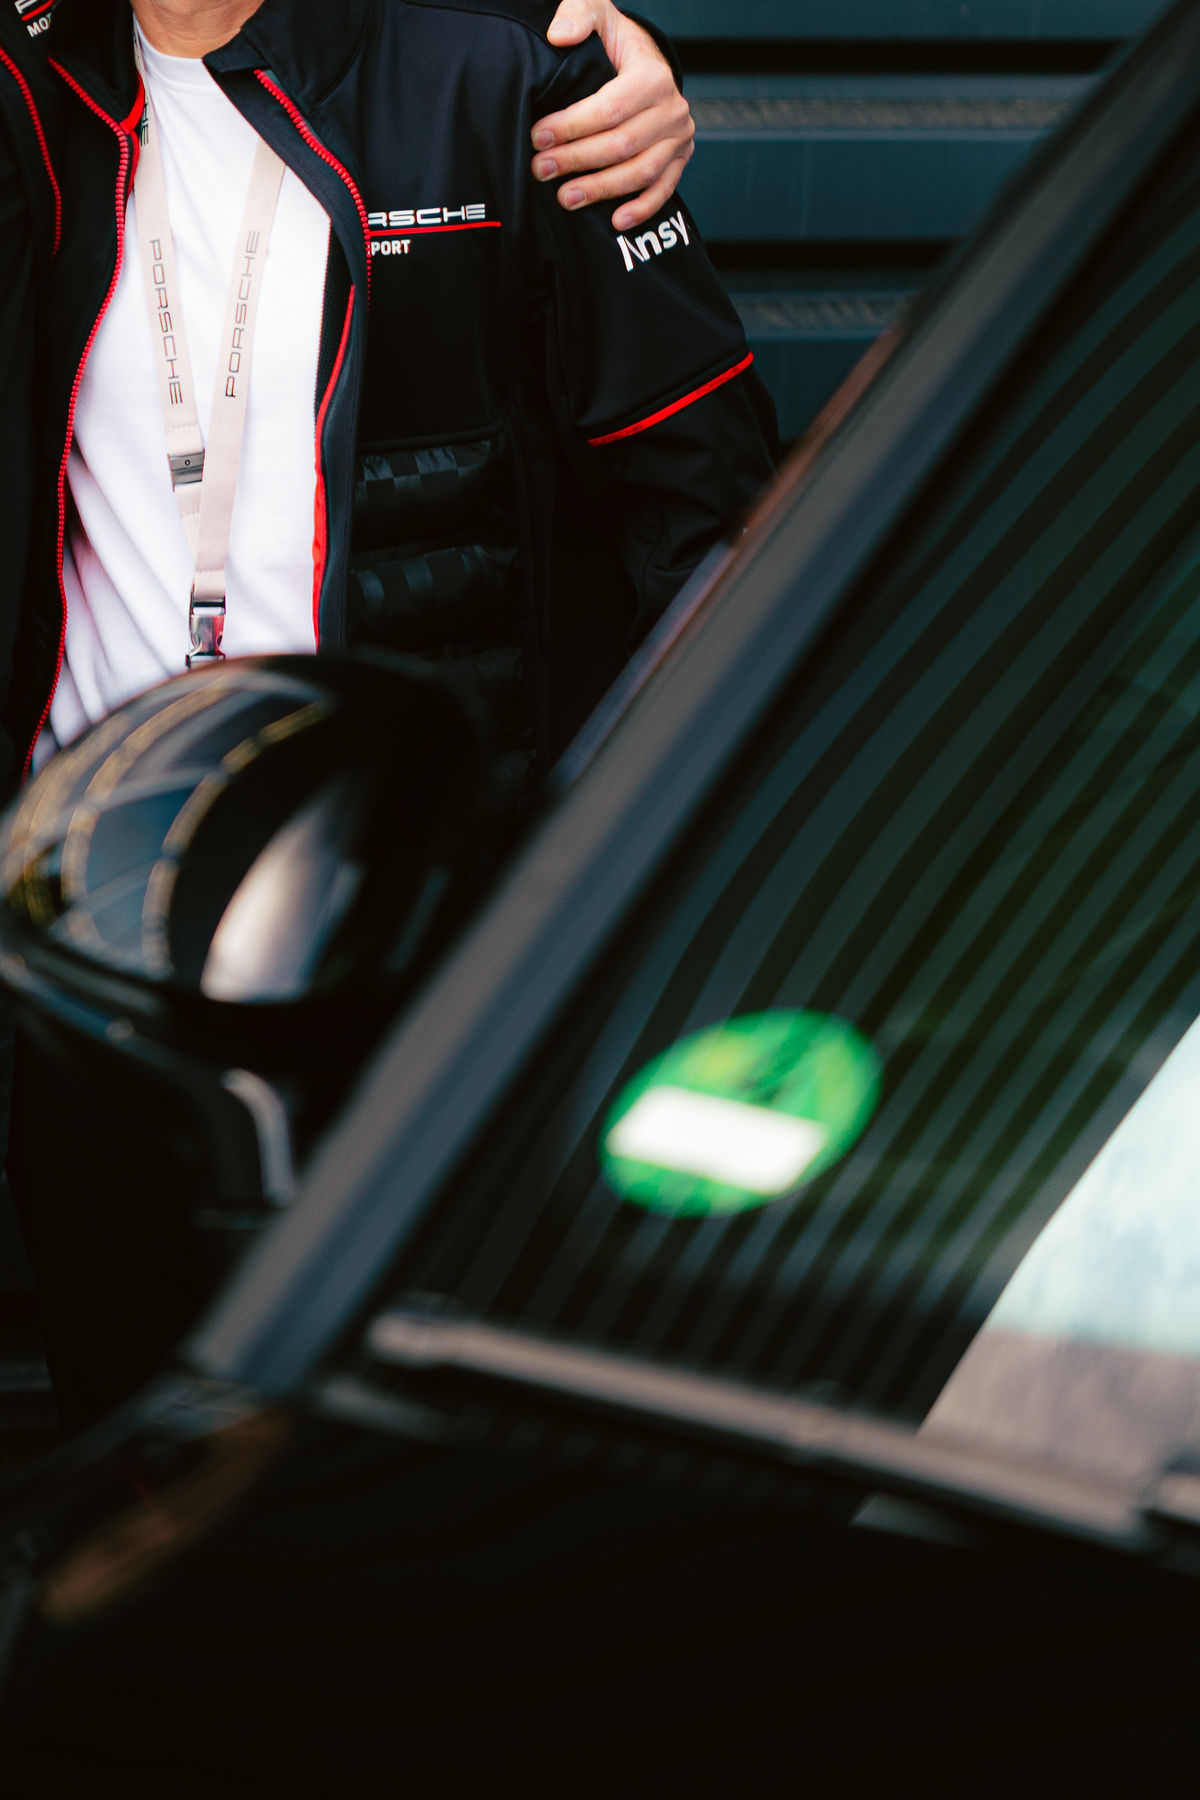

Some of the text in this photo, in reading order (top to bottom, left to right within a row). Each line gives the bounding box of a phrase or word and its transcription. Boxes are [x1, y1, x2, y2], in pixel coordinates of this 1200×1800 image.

[367, 239, 412, 257] PORT
[615, 210, 690, 272] Ansy
[150, 238, 183, 406] PORSCHE
[225, 229, 261, 398] PORSCHE
